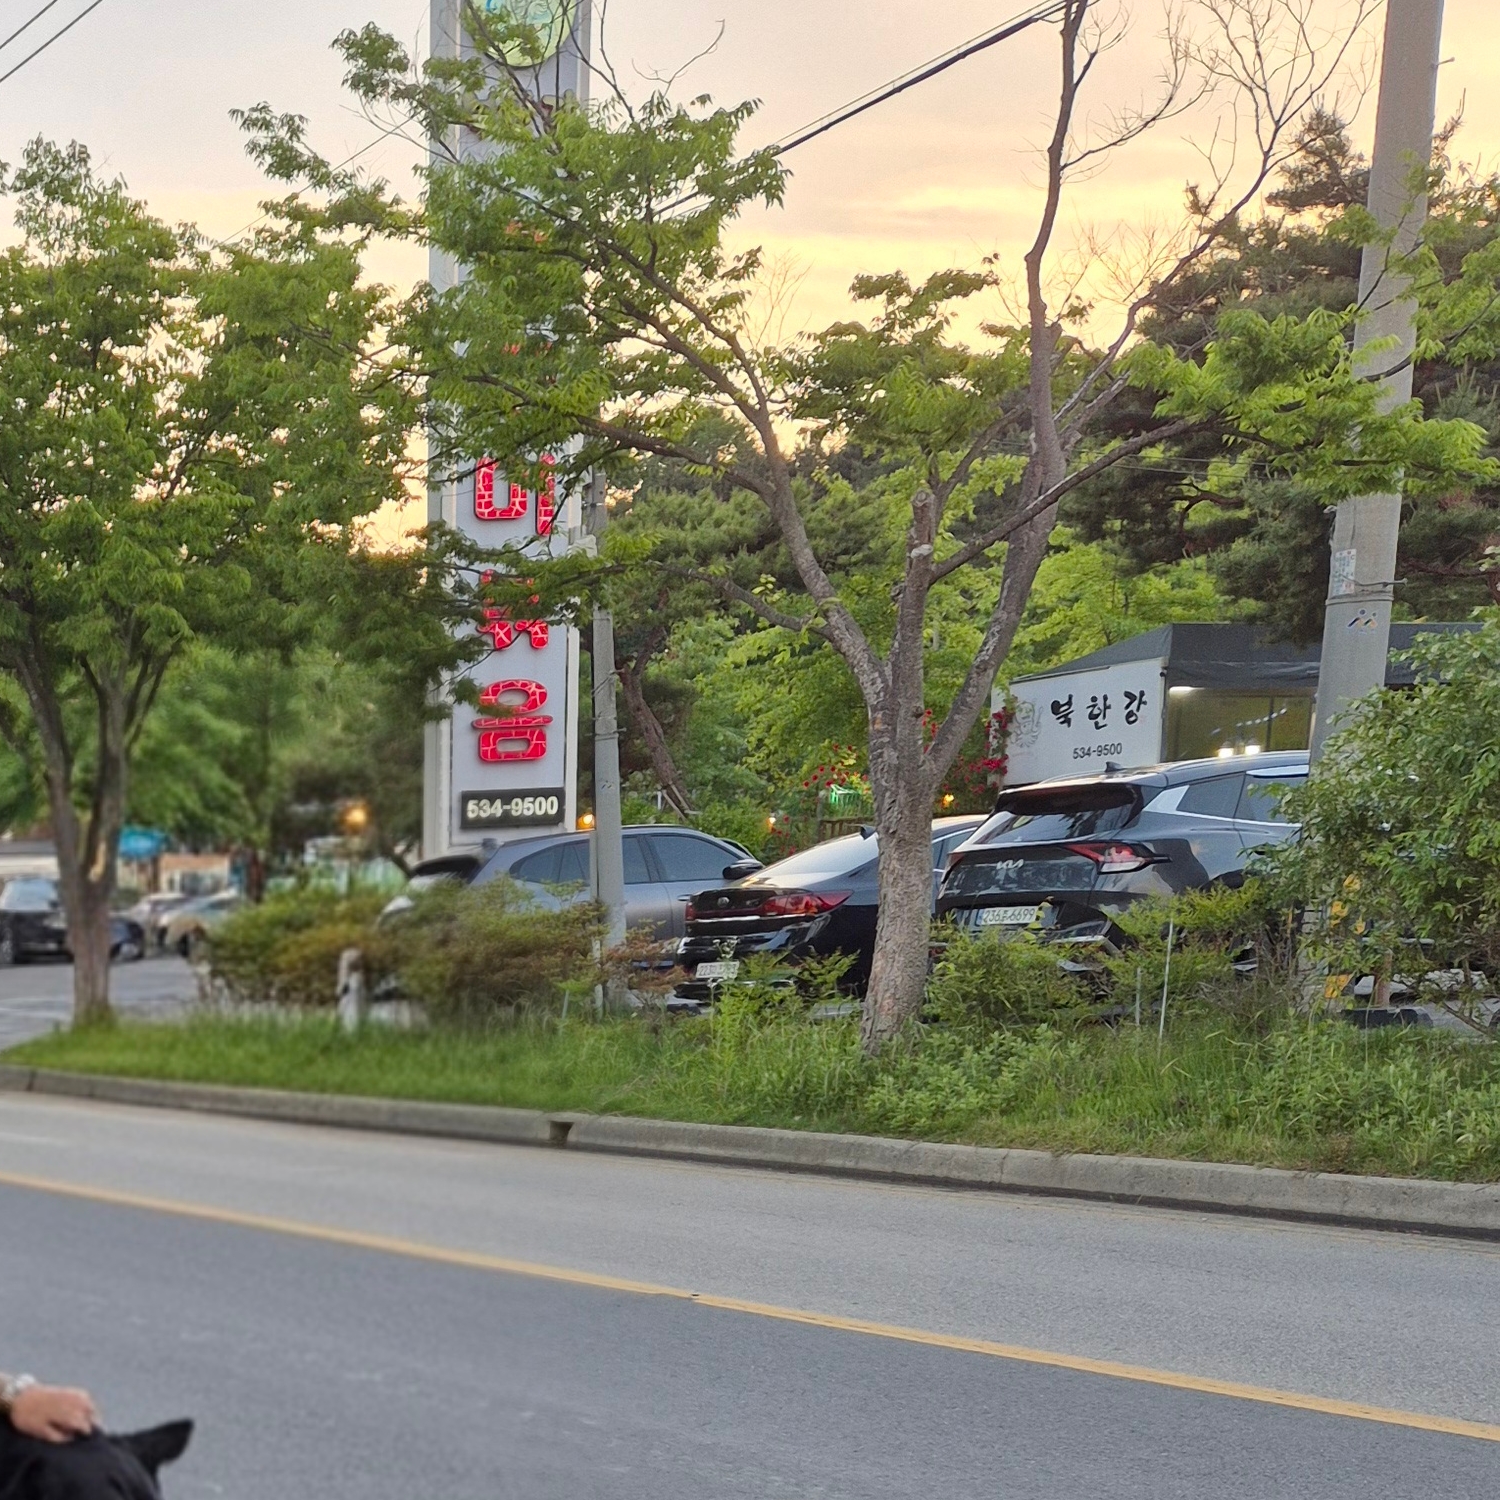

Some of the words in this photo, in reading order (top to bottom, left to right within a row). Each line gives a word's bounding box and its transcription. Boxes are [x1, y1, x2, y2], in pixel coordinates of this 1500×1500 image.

[1051, 689, 1148, 730] 북한강
[1072, 742, 1123, 760] 534-9500
[466, 794, 559, 820] 534-9500
